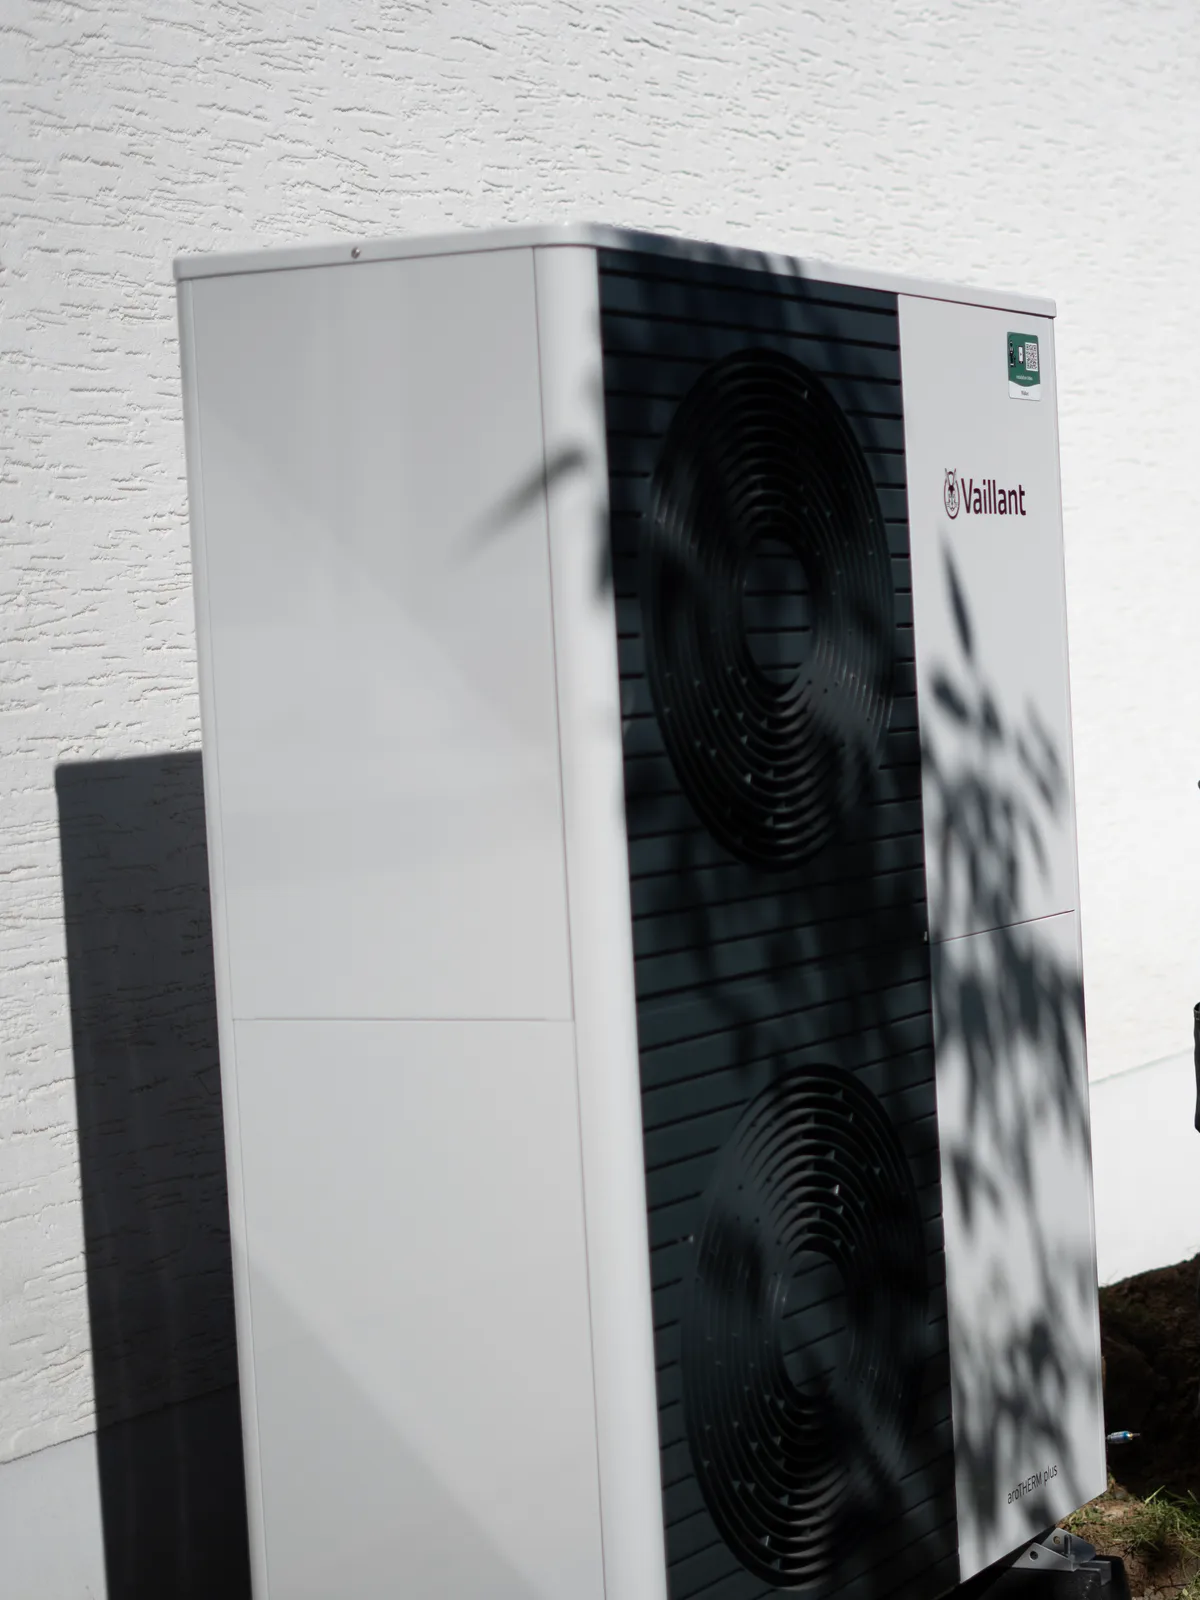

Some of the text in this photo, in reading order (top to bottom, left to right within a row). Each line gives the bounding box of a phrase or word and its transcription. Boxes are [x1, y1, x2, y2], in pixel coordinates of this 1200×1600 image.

[961, 478, 1026, 516] Vaillant
[1007, 1465, 1058, 1504] aroTHERM plus
